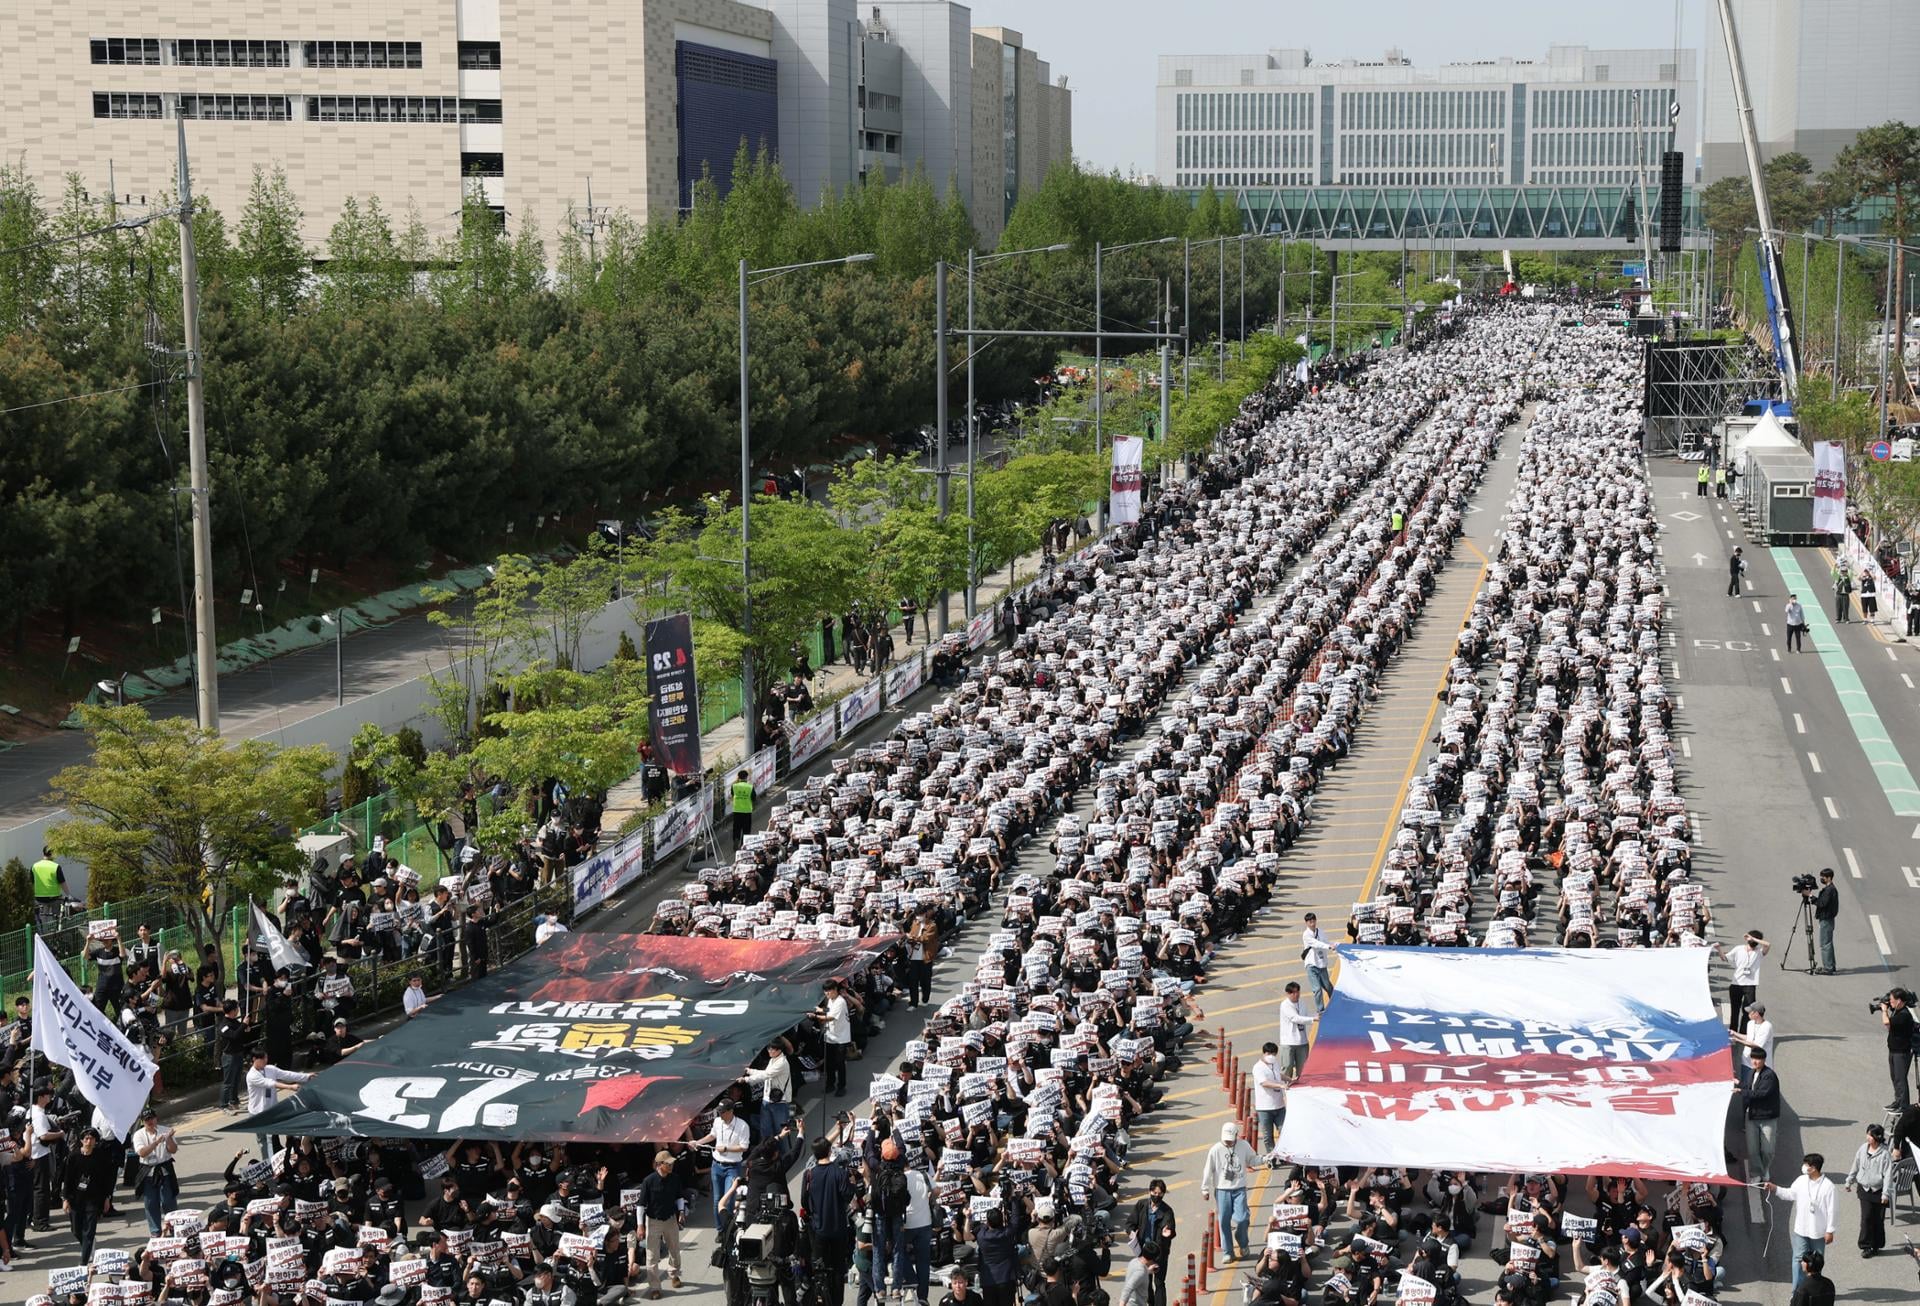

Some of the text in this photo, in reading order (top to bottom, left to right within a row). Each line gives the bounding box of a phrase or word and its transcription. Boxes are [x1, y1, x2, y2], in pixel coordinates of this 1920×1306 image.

[45, 973, 146, 1082] 성디스플레이
[1276, 1208, 1304, 1217] 투명하게
[1564, 1218, 1592, 1227] 상한폐지
[52, 1267, 83, 1280] 상한폐지
[268, 1270, 299, 1279] 투명하게
[392, 1263, 421, 1276] 투명하게
